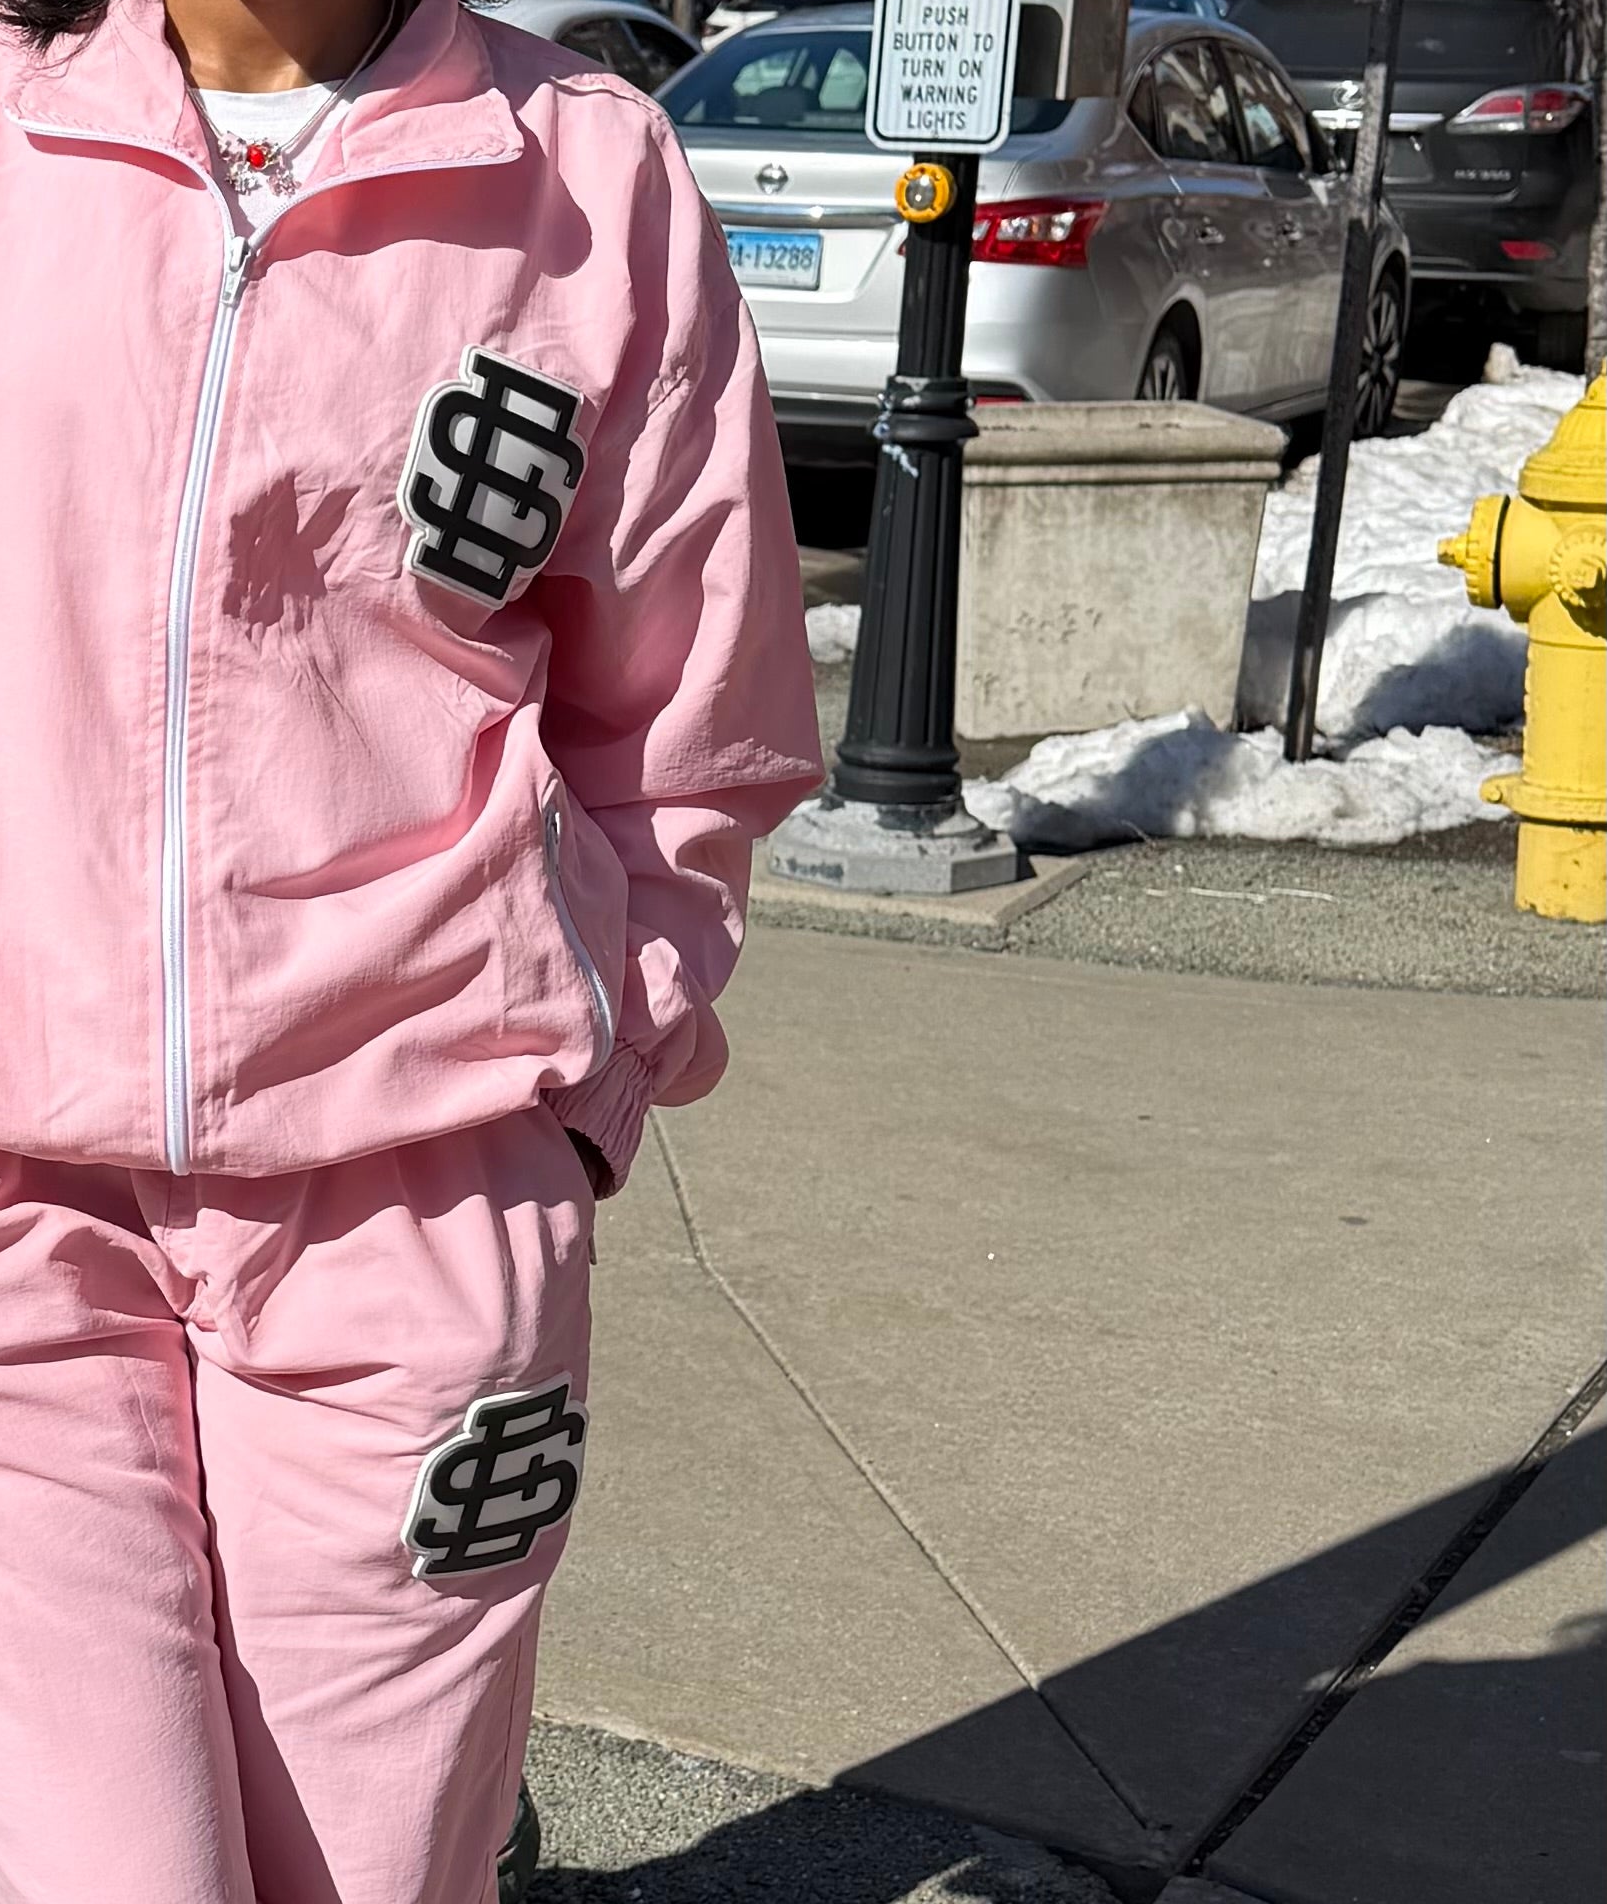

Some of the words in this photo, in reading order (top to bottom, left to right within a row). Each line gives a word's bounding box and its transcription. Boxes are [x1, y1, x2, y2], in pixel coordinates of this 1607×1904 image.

[921, 5, 969, 26] PUSH
[893, 31, 959, 52] BUTTON
[973, 33, 994, 53] TO
[901, 58, 945, 78] TURN
[959, 59, 983, 79] ON
[901, 84, 978, 105] WARNING
[907, 110, 967, 131] LIGHTS
